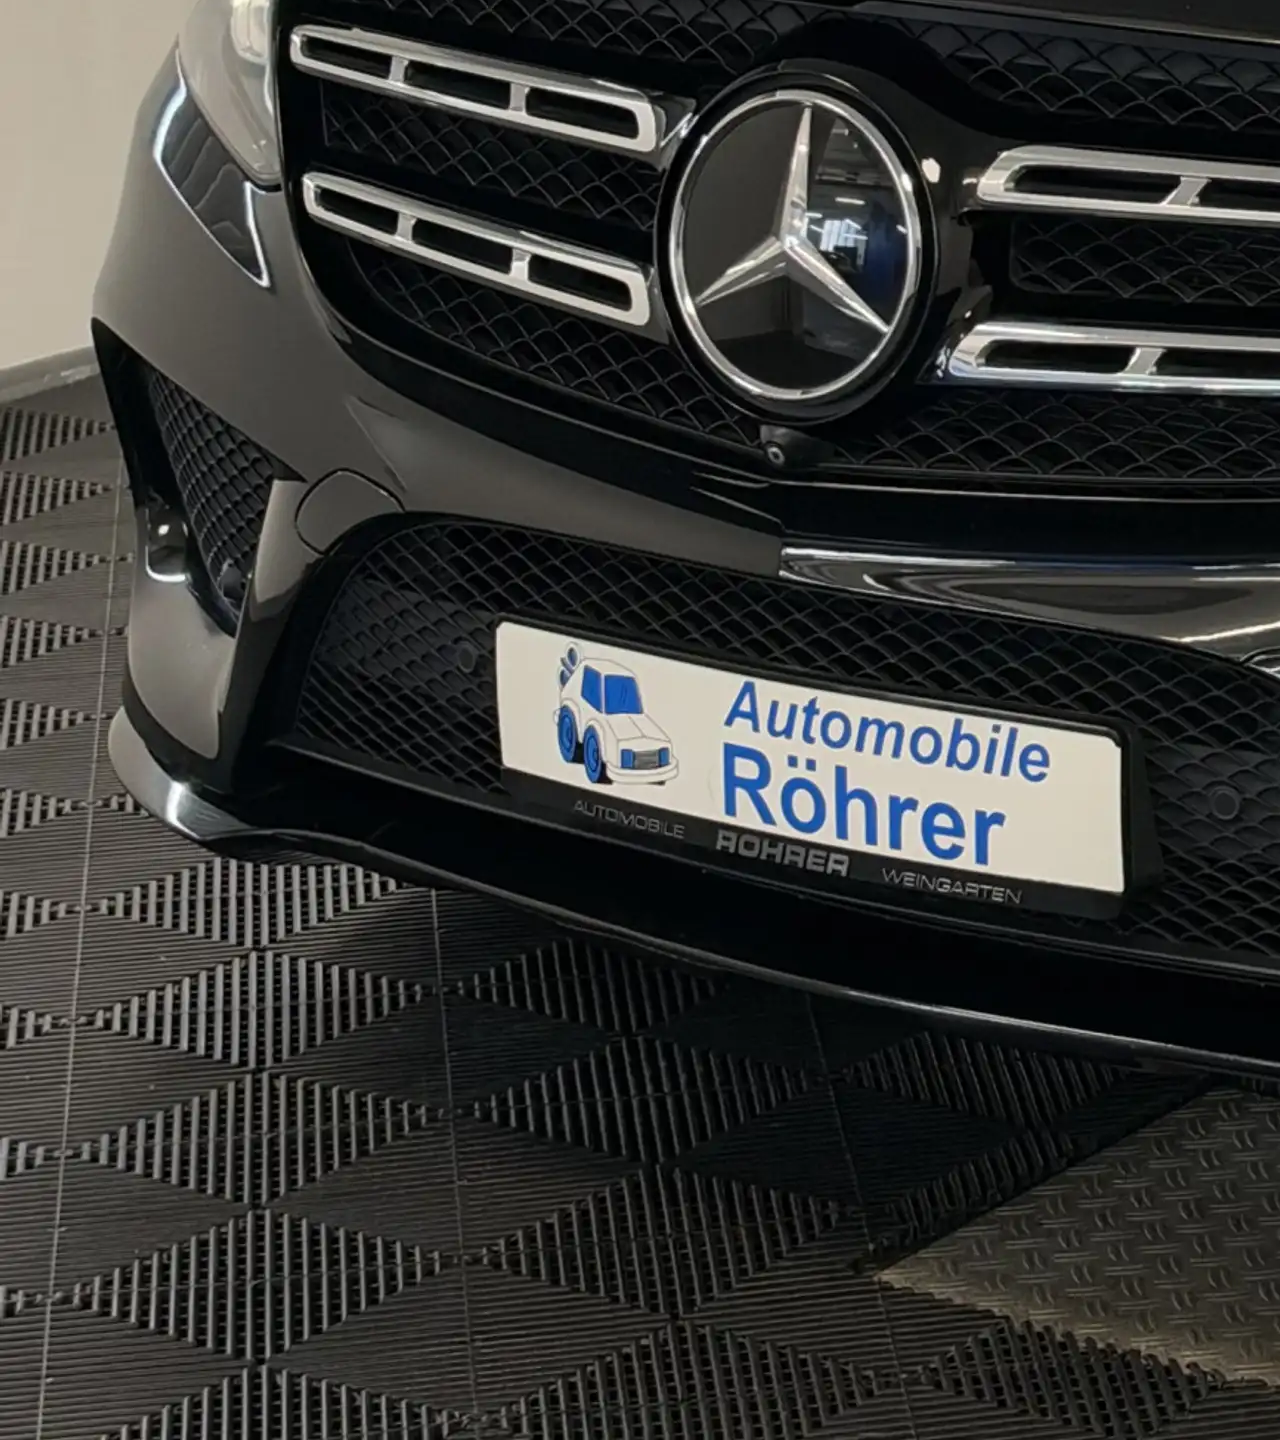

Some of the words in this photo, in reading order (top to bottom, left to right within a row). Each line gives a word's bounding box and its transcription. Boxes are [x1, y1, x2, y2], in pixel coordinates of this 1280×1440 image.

[723, 681, 1051, 783] Automobile
[572, 799, 686, 840] AUTOMOBILE
[881, 867, 1024, 905] WEINGARTEN
[723, 742, 1007, 866] Röhrer
